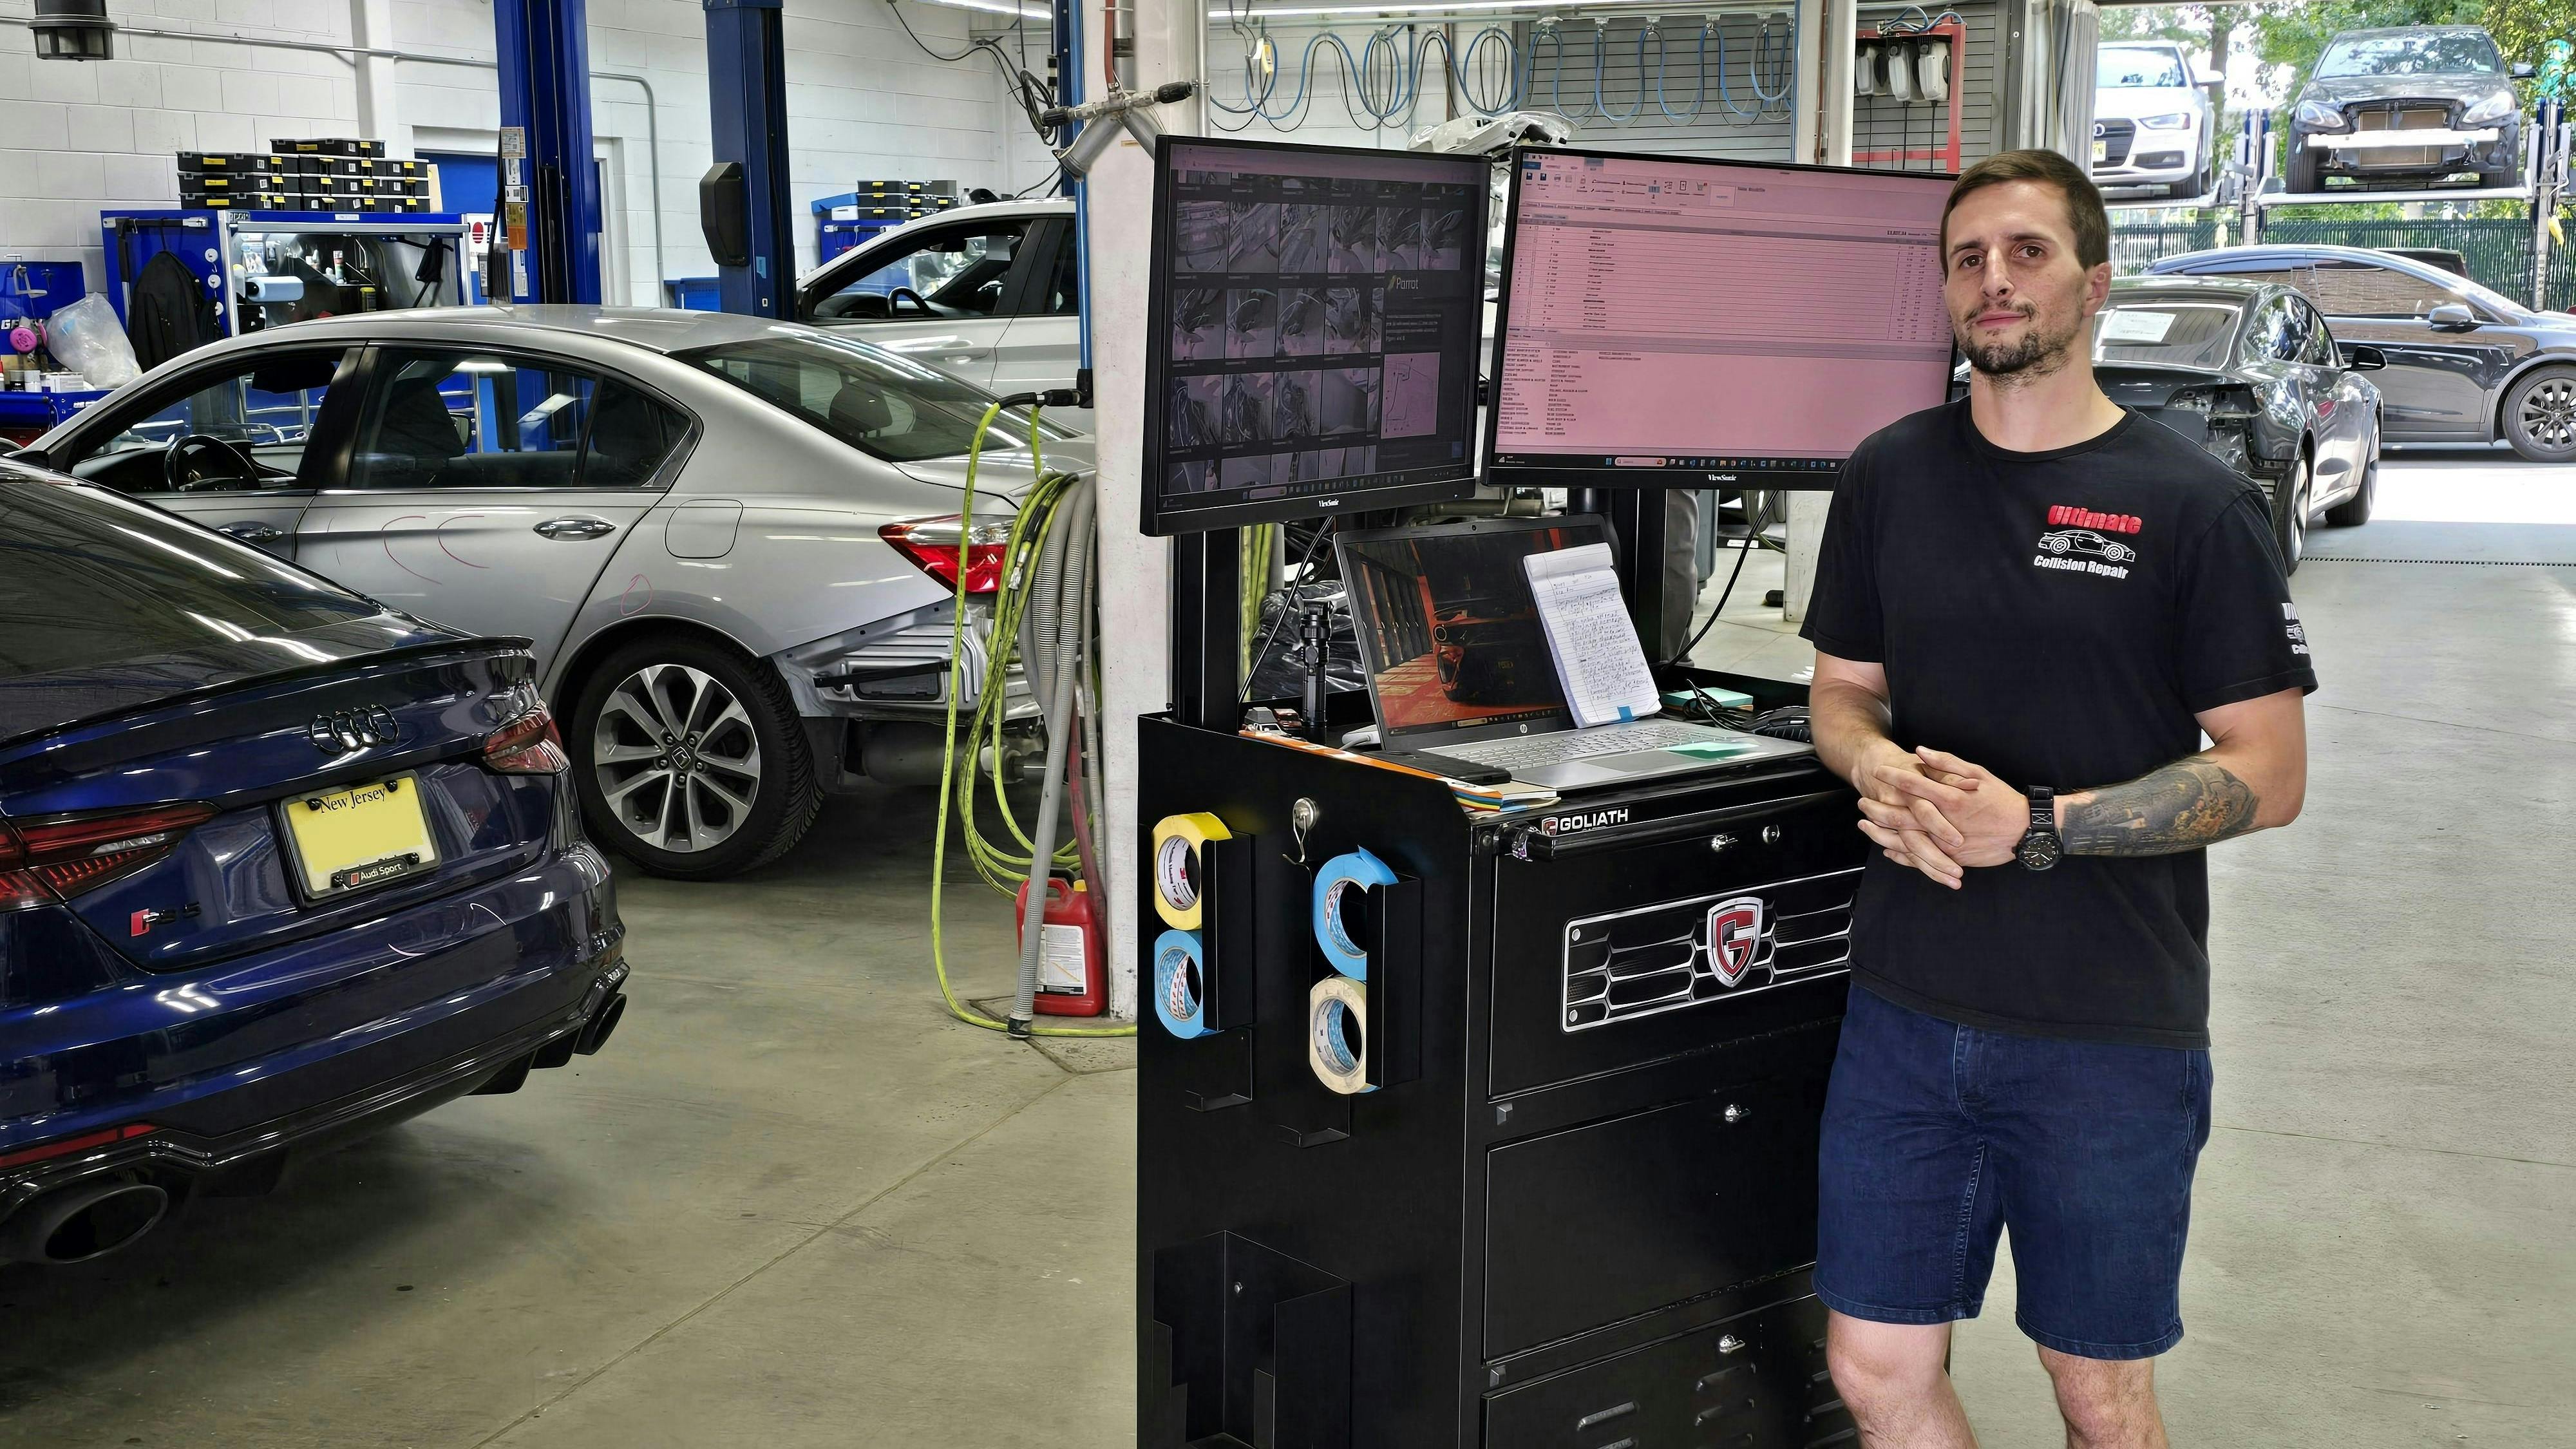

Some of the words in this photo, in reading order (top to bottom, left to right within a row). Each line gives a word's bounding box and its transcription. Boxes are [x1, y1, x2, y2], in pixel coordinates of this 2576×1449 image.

[1396, 277, 1419, 290] Parrot
[2047, 505, 2143, 535] Ultimate
[2034, 554, 2087, 571] Collision
[2087, 560, 2129, 580] Repair
[319, 797, 348, 813] New
[350, 787, 386, 810] Jersey
[1560, 808, 1629, 831] GOLIATH
[359, 868, 379, 881] Audi
[379, 863, 402, 876] Sport
